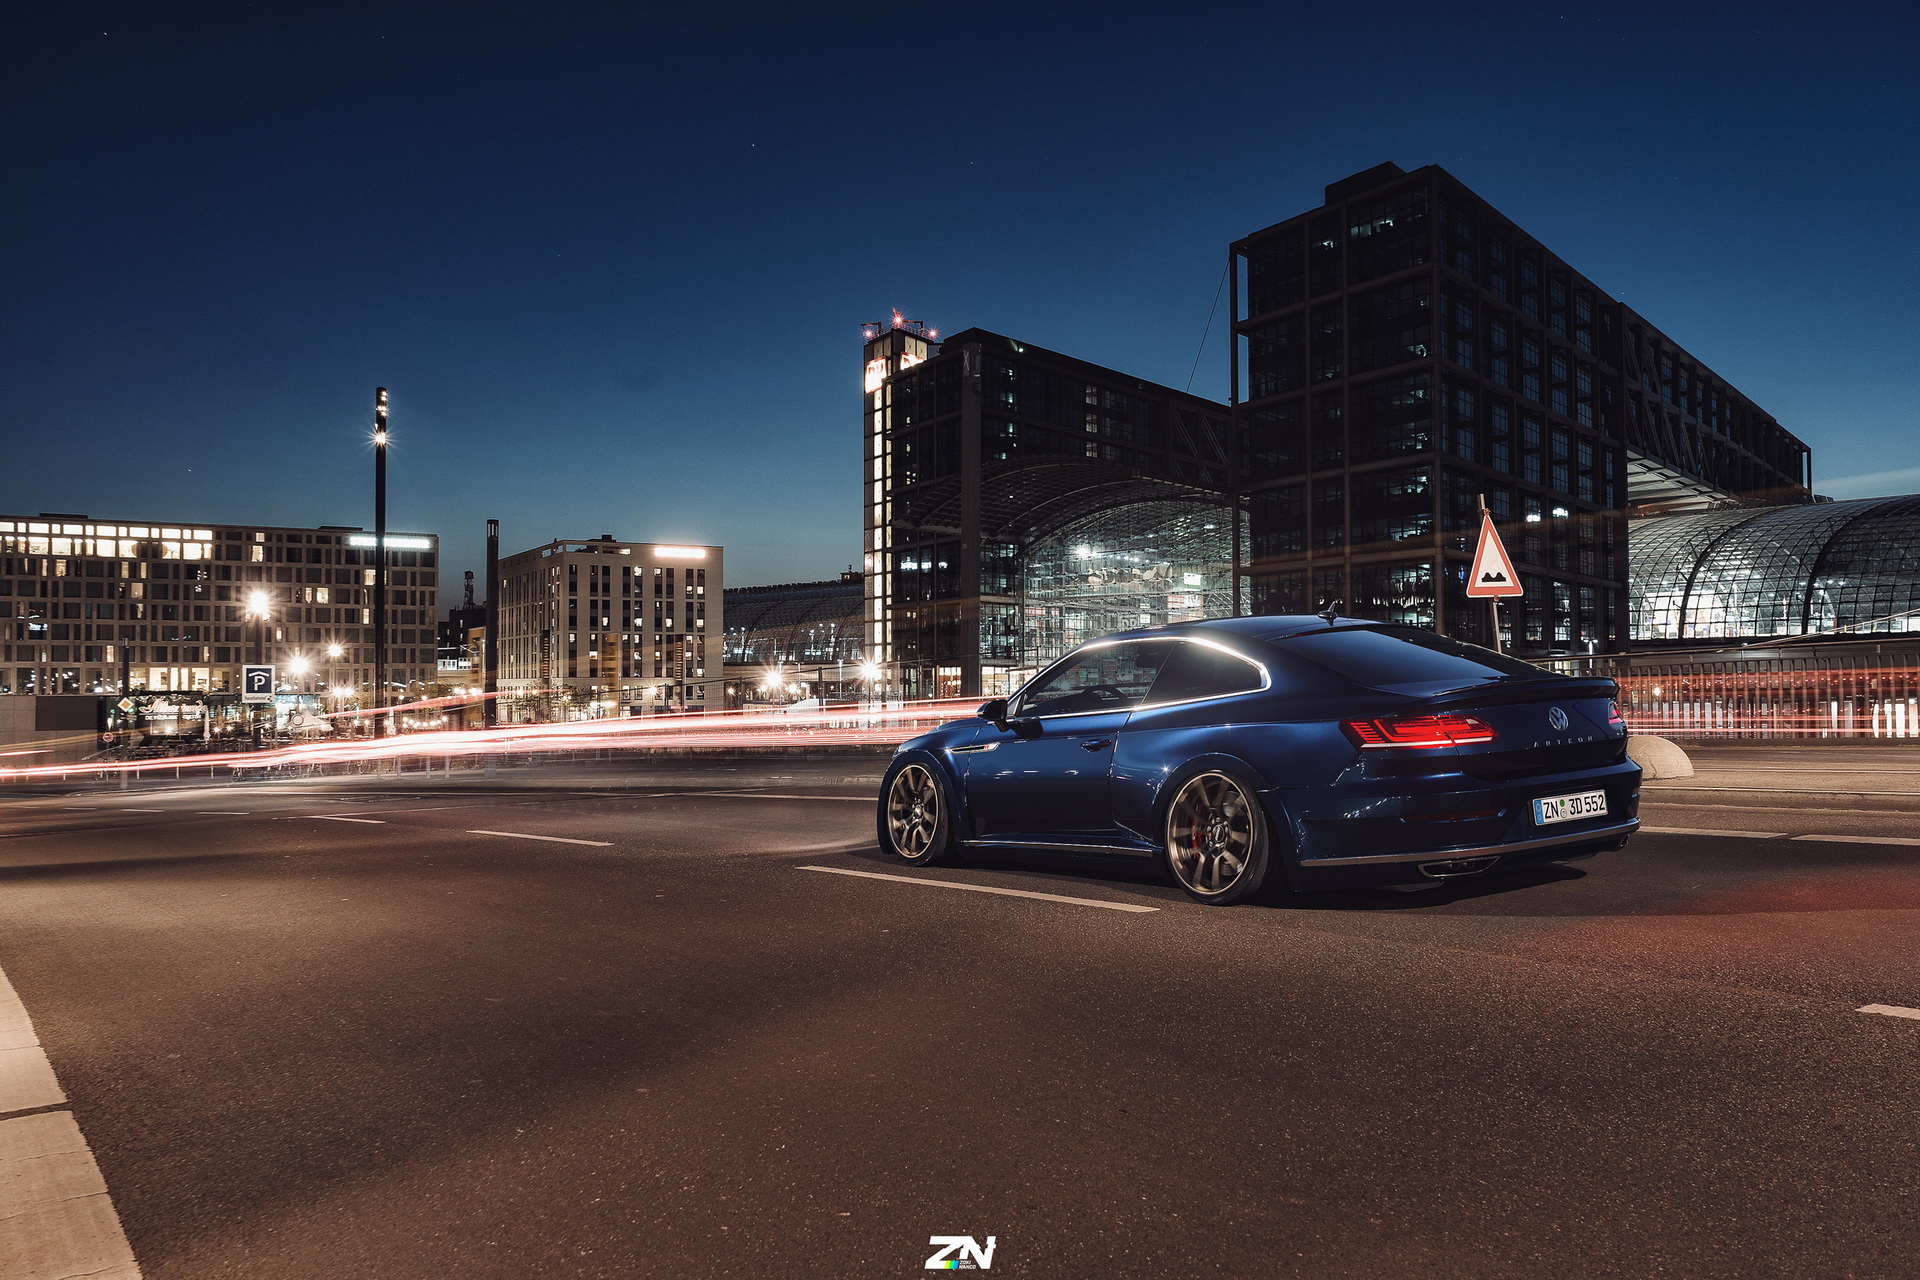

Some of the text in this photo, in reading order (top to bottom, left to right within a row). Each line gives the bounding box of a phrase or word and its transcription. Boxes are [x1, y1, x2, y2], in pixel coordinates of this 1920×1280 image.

[254, 675, 266, 691] P
[1548, 706, 1569, 730] VW
[1533, 735, 1593, 748] ARTEON
[1543, 794, 1605, 819] ZN 3D 552
